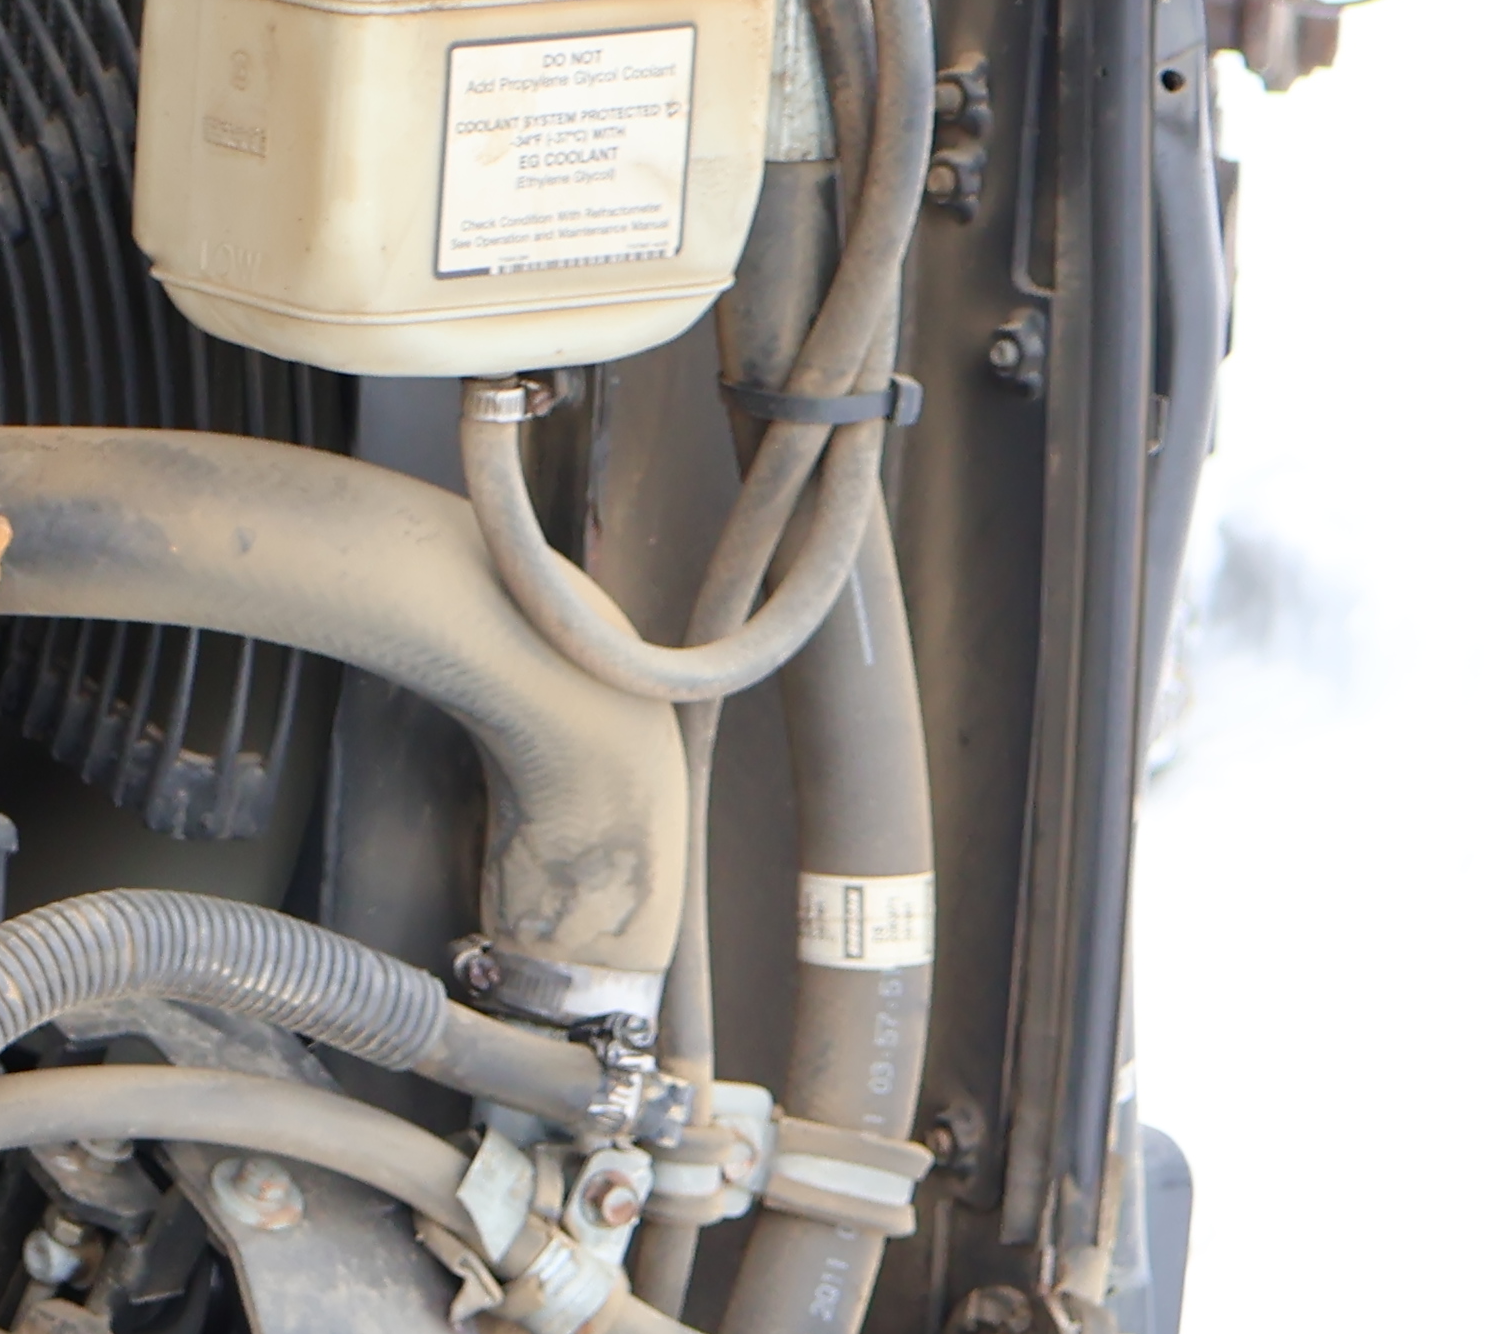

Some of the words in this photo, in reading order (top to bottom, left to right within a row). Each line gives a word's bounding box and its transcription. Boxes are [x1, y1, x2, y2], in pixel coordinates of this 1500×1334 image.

[542, 53, 566, 68] DO
[570, 49, 604, 65] NOT
[465, 78, 496, 95] Add
[499, 73, 569, 94] Propylene
[574, 67, 617, 88] Glycol
[622, 62, 678, 81] Coolant
[455, 116, 520, 134] COOLANT
[523, 111, 577, 129] SYSTEM
[580, 103, 661, 122] PROTECTED
[592, 124, 627, 140] WITH
[518, 153, 541, 170] EG
[543, 146, 619, 167] COOLANT
[515, 171, 570, 191] (Ethylene
[574, 166, 617, 186] Glycol)
[460, 217, 496, 233] Check
[499, 212, 553, 229] Condition
[557, 208, 581, 222] With
[585, 202, 663, 219] Refractometer
[450, 237, 472, 251] See
[475, 231, 530, 249] Operation
[534, 229, 554, 242] and
[558, 223, 628, 239] Maintenance
[631, 218, 670, 232] Manual
